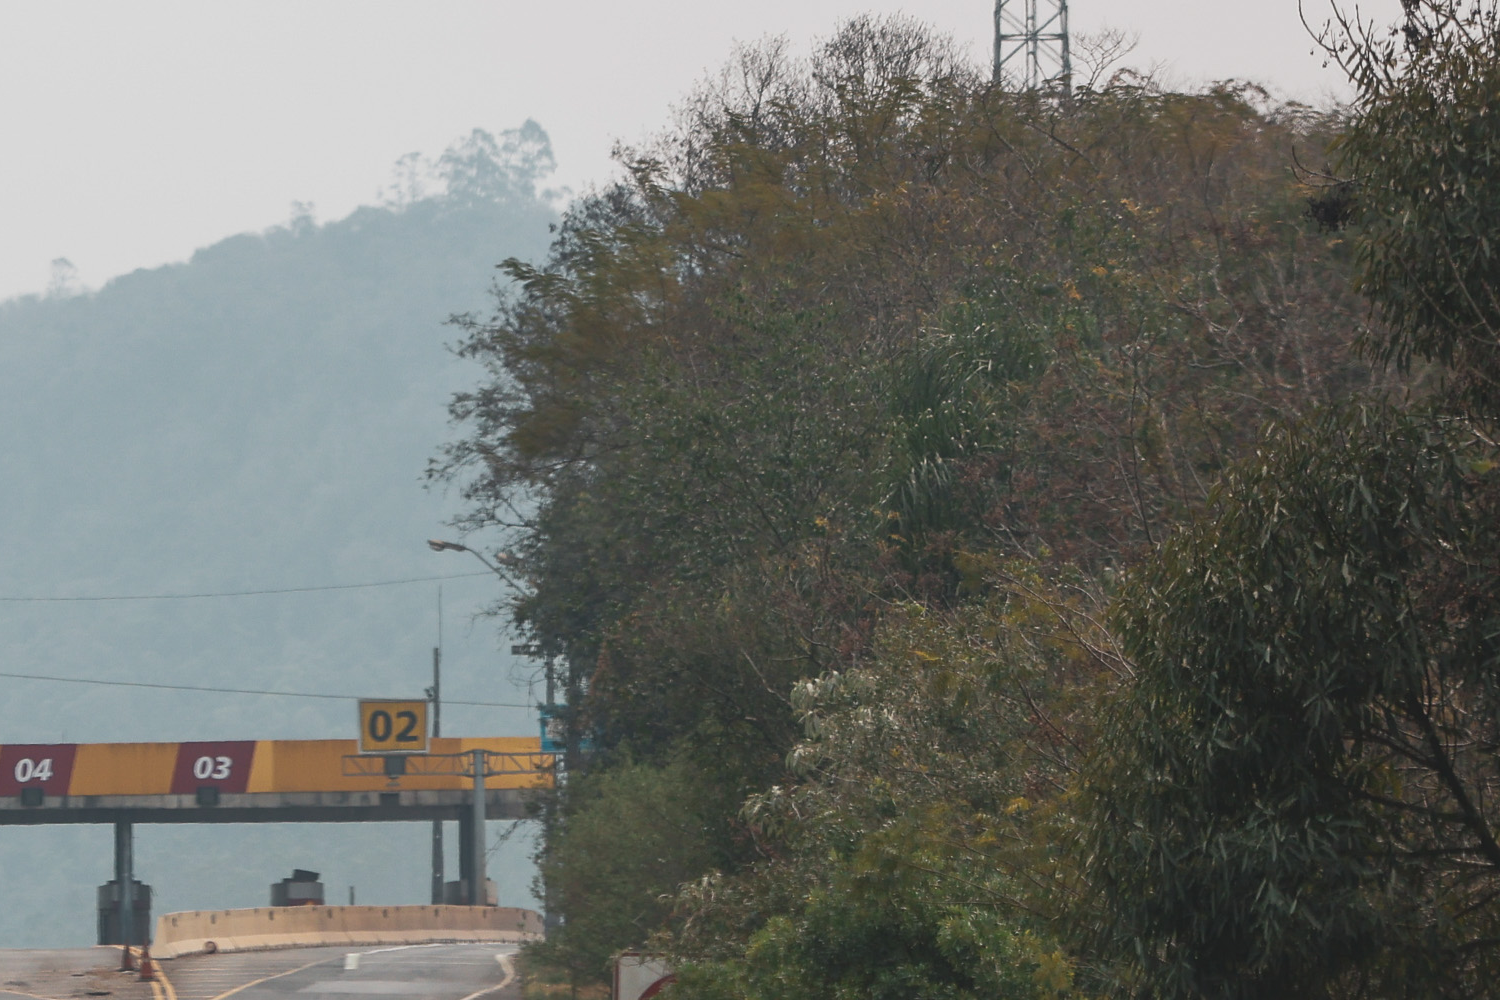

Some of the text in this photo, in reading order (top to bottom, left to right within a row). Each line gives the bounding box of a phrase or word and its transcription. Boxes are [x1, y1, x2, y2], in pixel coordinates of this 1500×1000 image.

[369, 710, 419, 742] 02
[14, 758, 53, 783] 04
[193, 756, 233, 780] 03
